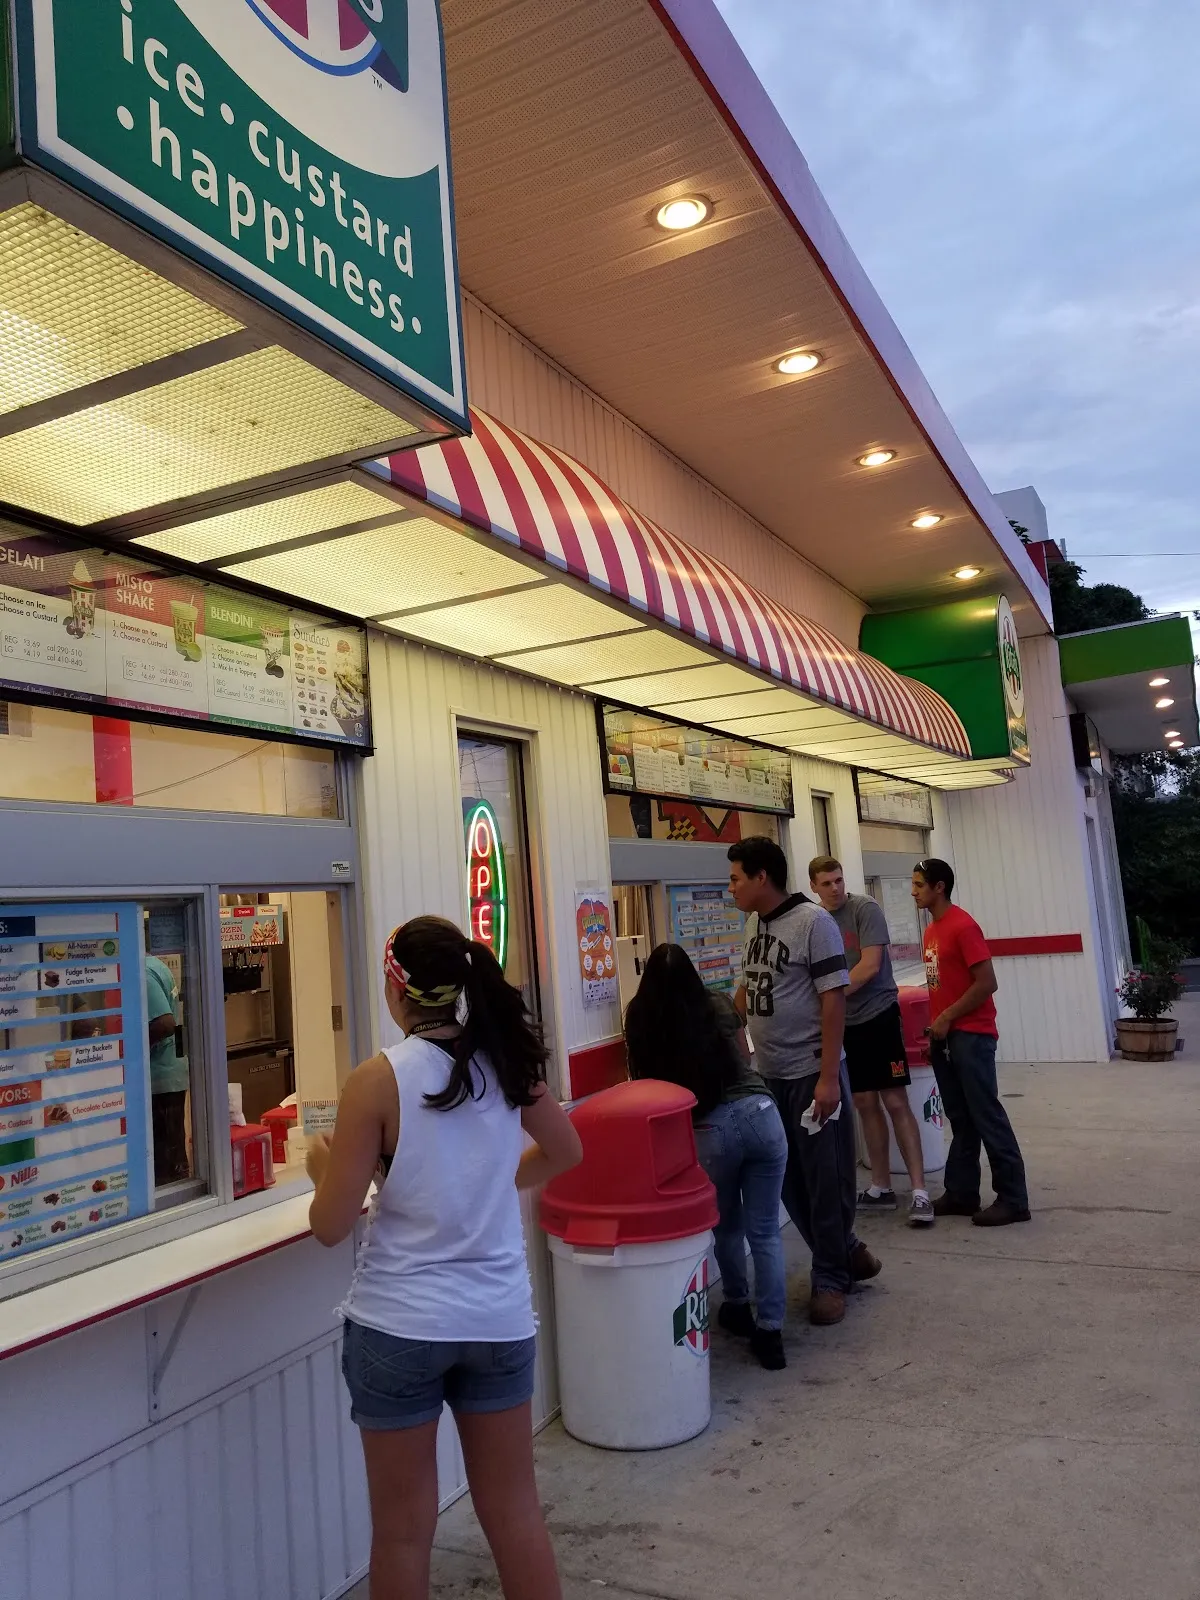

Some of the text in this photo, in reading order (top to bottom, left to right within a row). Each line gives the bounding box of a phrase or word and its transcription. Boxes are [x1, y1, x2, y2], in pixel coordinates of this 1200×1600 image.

[120, 0, 414, 278] ice custard
[150, 97, 405, 334] happiness
[0, 546, 44, 572] GELATI
[115, 572, 153, 594] MISTO
[26, 600, 35, 608] an
[36, 601, 46, 610] Ice
[116, 588, 155, 612] SHAKE
[32, 611, 58, 623] Custard
[210, 606, 253, 629] BLENDINI
[119, 621, 141, 633] Choose
[4, 635, 18, 644] REG
[119, 631, 141, 643] Choose
[147, 638, 168, 649] Custard
[293, 622, 331, 648] Sundaes
[4, 645, 14, 653] LG
[217, 654, 235, 664] Choose
[67, 941, 99, 950] All-Natural
[67, 951, 96, 960] Pineapple
[65, 966, 107, 977] Fudge Brownie
[65, 978, 85, 986] Cream
[75, 1043, 113, 1056] Party Buckets
[75, 1054, 104, 1065] Available!
[8, 1116, 33, 1129] Custard
[72, 1104, 101, 1115] Chocolate
[101, 1097, 123, 1109] Custard
[11, 1166, 38, 1188] Nilla
